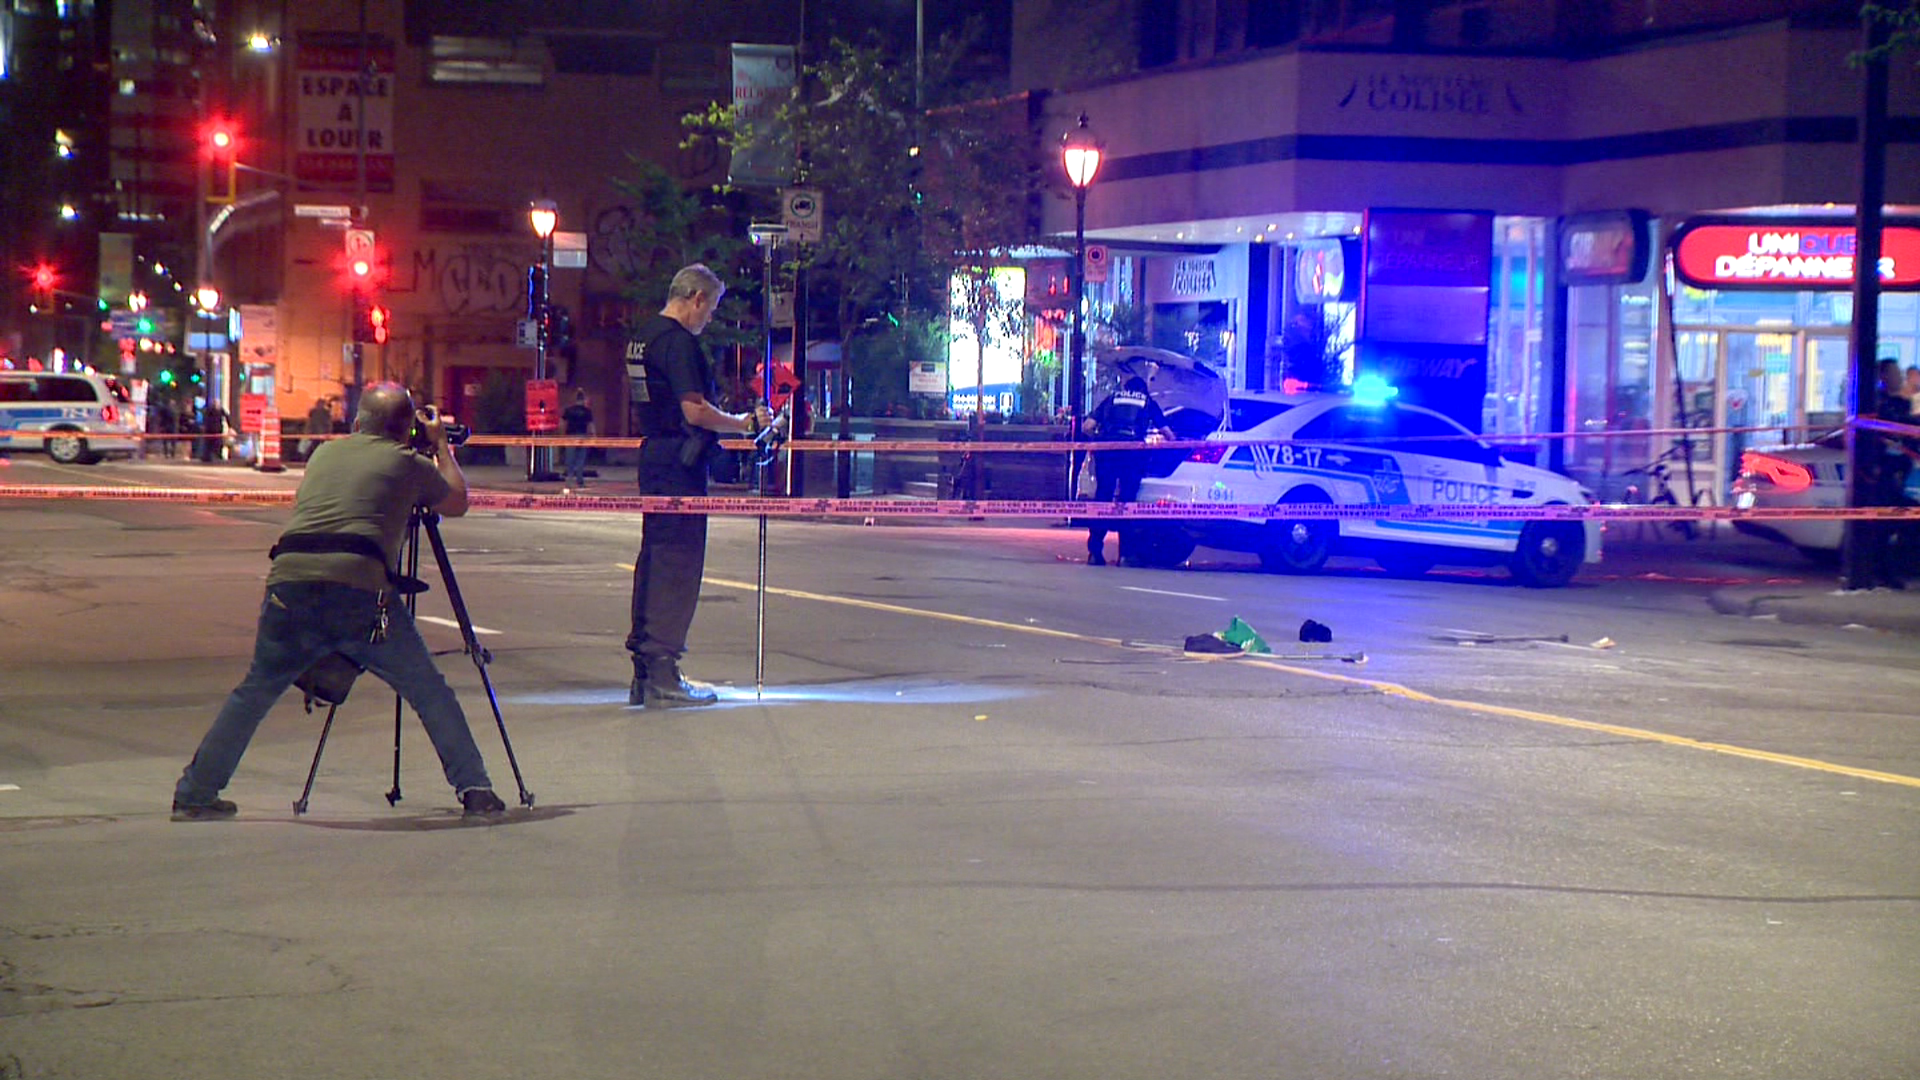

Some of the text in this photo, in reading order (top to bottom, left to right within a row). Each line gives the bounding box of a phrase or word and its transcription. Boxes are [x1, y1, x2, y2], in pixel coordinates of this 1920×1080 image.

[1714, 250, 1897, 279] DÉPANNER
[1267, 444, 1323, 468] 78-17
[1432, 478, 1500, 505] POLICE
